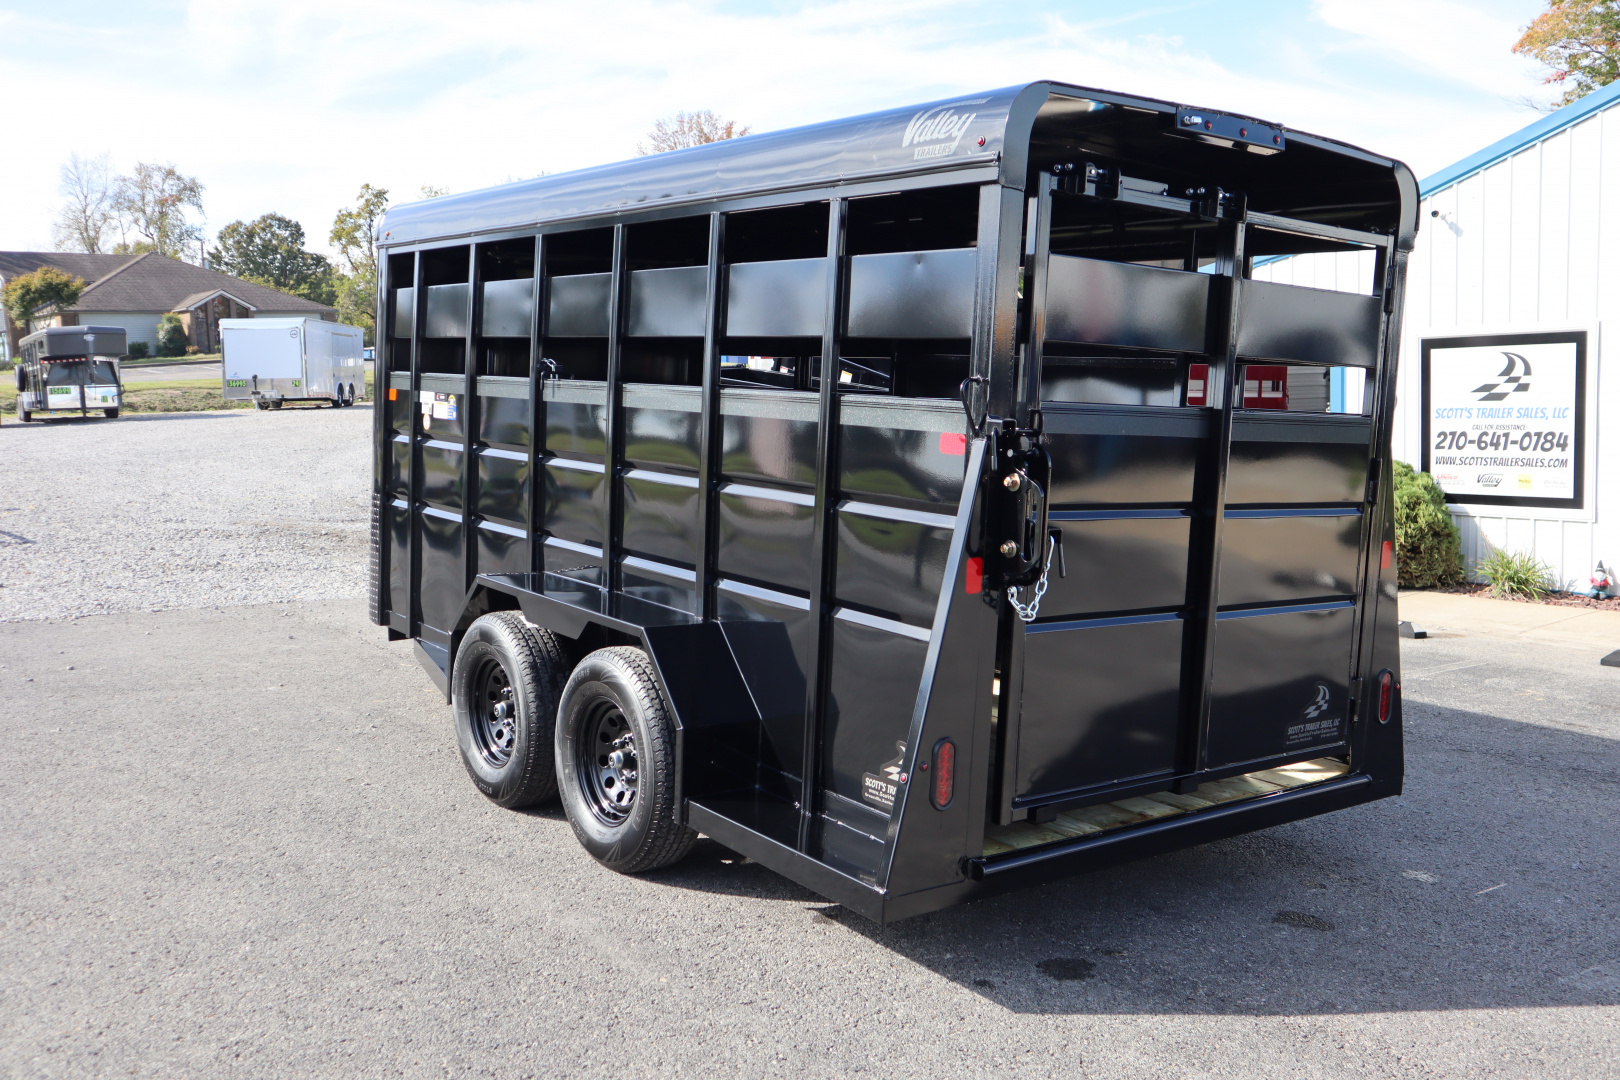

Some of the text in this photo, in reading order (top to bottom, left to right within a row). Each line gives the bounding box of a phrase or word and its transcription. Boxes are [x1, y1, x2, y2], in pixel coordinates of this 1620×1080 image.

[902, 104, 978, 152] Valley
[914, 144, 955, 159] TRAILERS
[1435, 407, 1569, 420] SCOTT'S TRAILER SALES, LLC
[1435, 431, 1569, 452] 270-641-0784
[1435, 456, 1568, 468] WWW.SCOTTSTRAILERSALES.COM
[1477, 474, 1503, 486] Valley
[865, 778, 887, 791] SCOTT'S
